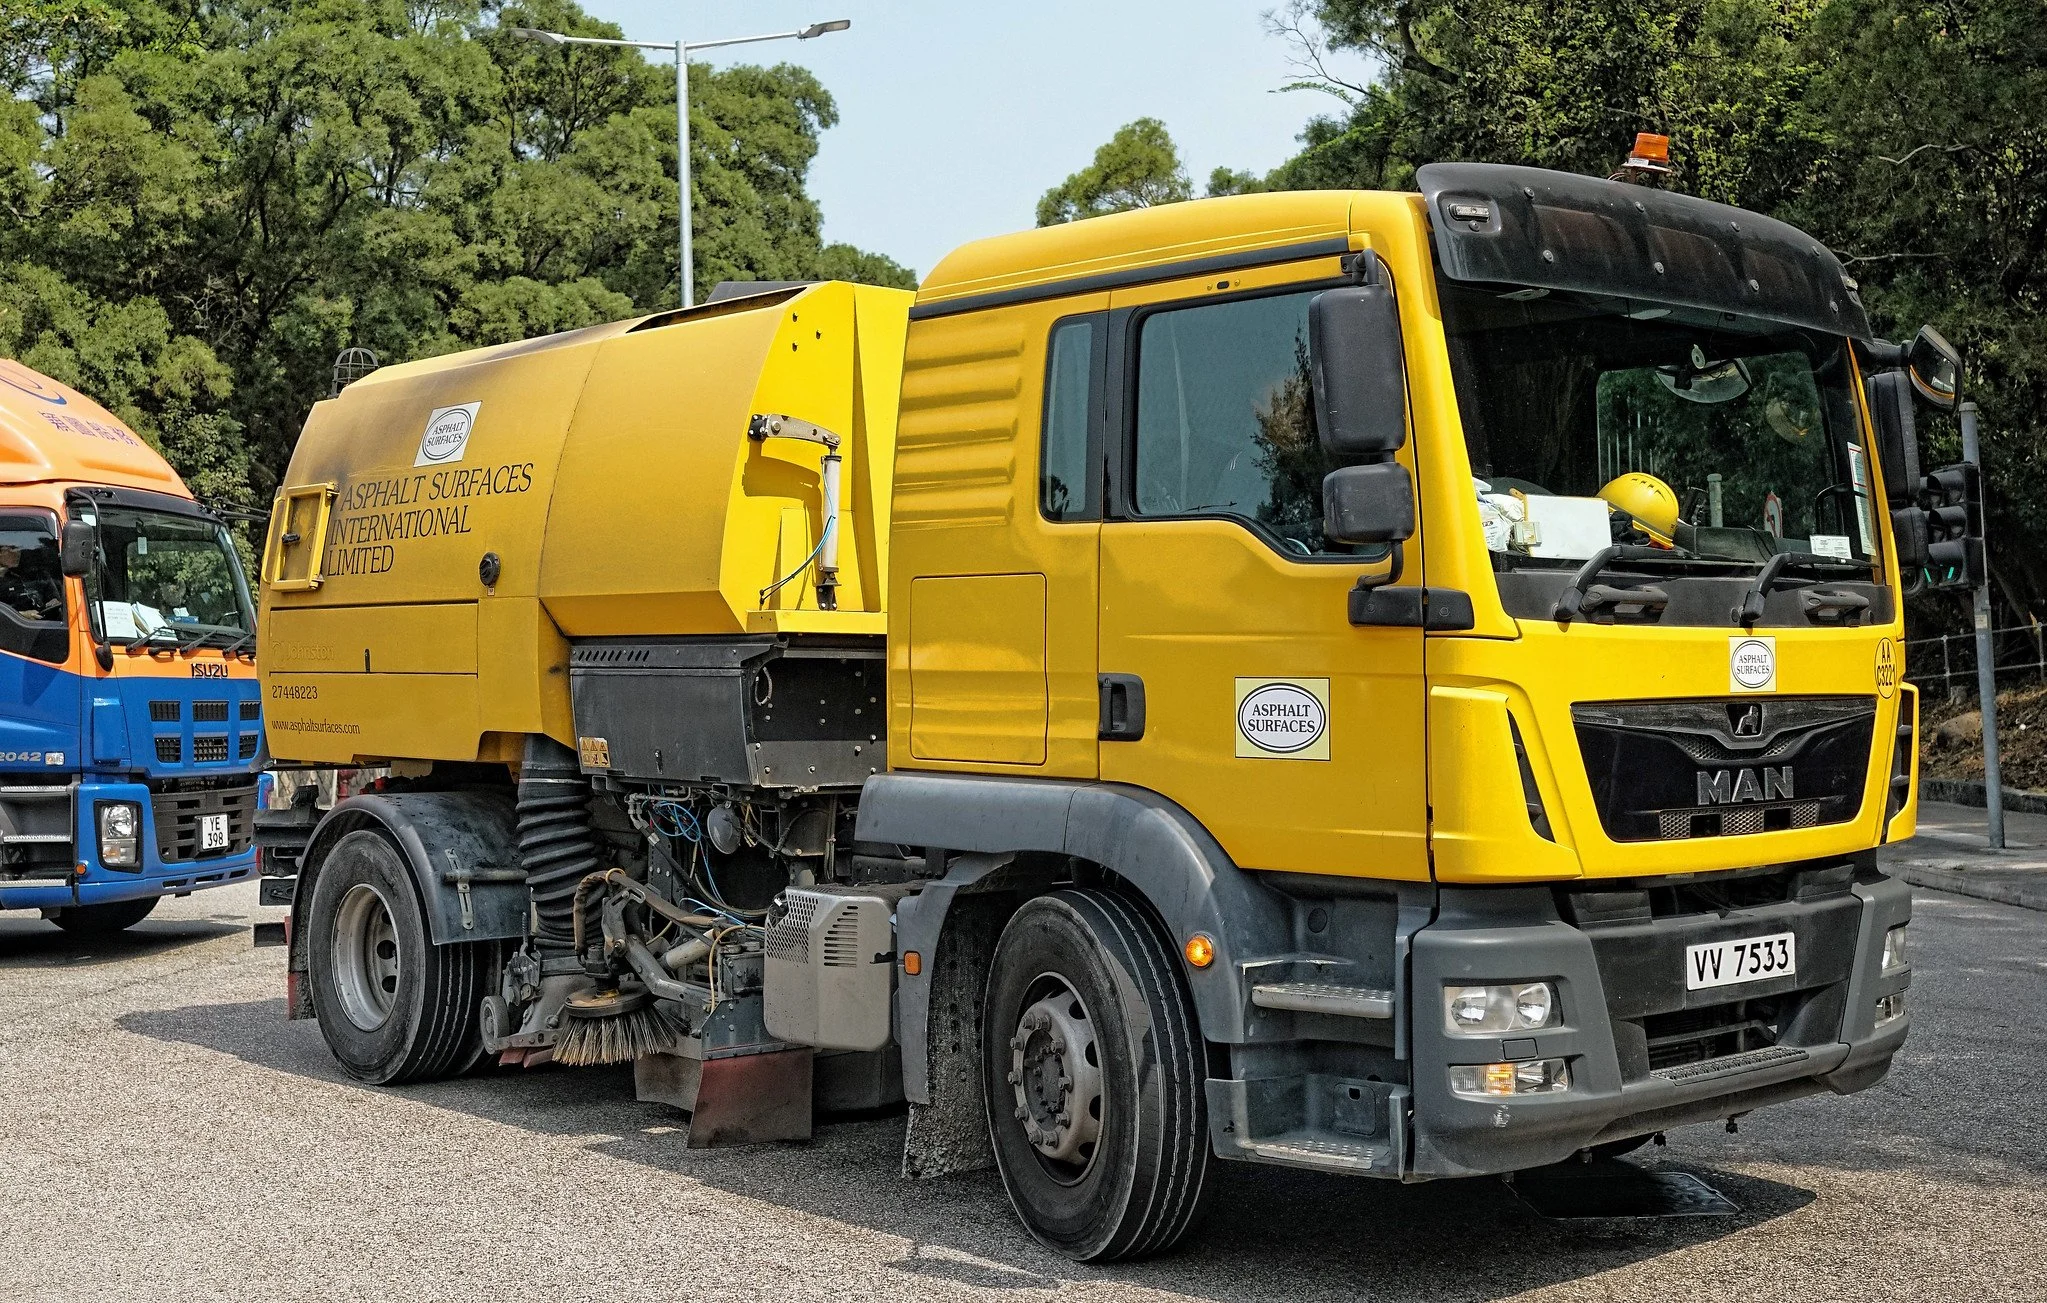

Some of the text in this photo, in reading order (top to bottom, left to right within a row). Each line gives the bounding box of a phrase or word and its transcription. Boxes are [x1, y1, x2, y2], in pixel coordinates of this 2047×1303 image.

[432, 421, 465, 435] ASPHALT
[427, 432, 463, 447] SURFACES
[339, 462, 534, 512] ASPHALT SURFACES
[329, 504, 472, 546] INTERNATIONAL
[326, 545, 394, 577] LIMITED
[1738, 654, 1767, 664] ASPHALT
[191, 663, 229, 679] ISUZU
[1736, 664, 1770, 675] SURFACES
[1876, 663, 1896, 687] C3221
[271, 685, 319, 700] 27448223
[1252, 703, 1311, 718] ASPHALT
[271, 717, 361, 735] www.asphaltsurfaces.com
[1247, 719, 1316, 734] SURFACES
[1696, 766, 1794, 806] MAN
[210, 816, 221, 831] YE
[207, 831, 224, 847] 398
[1694, 939, 1789, 982] VV 7533
